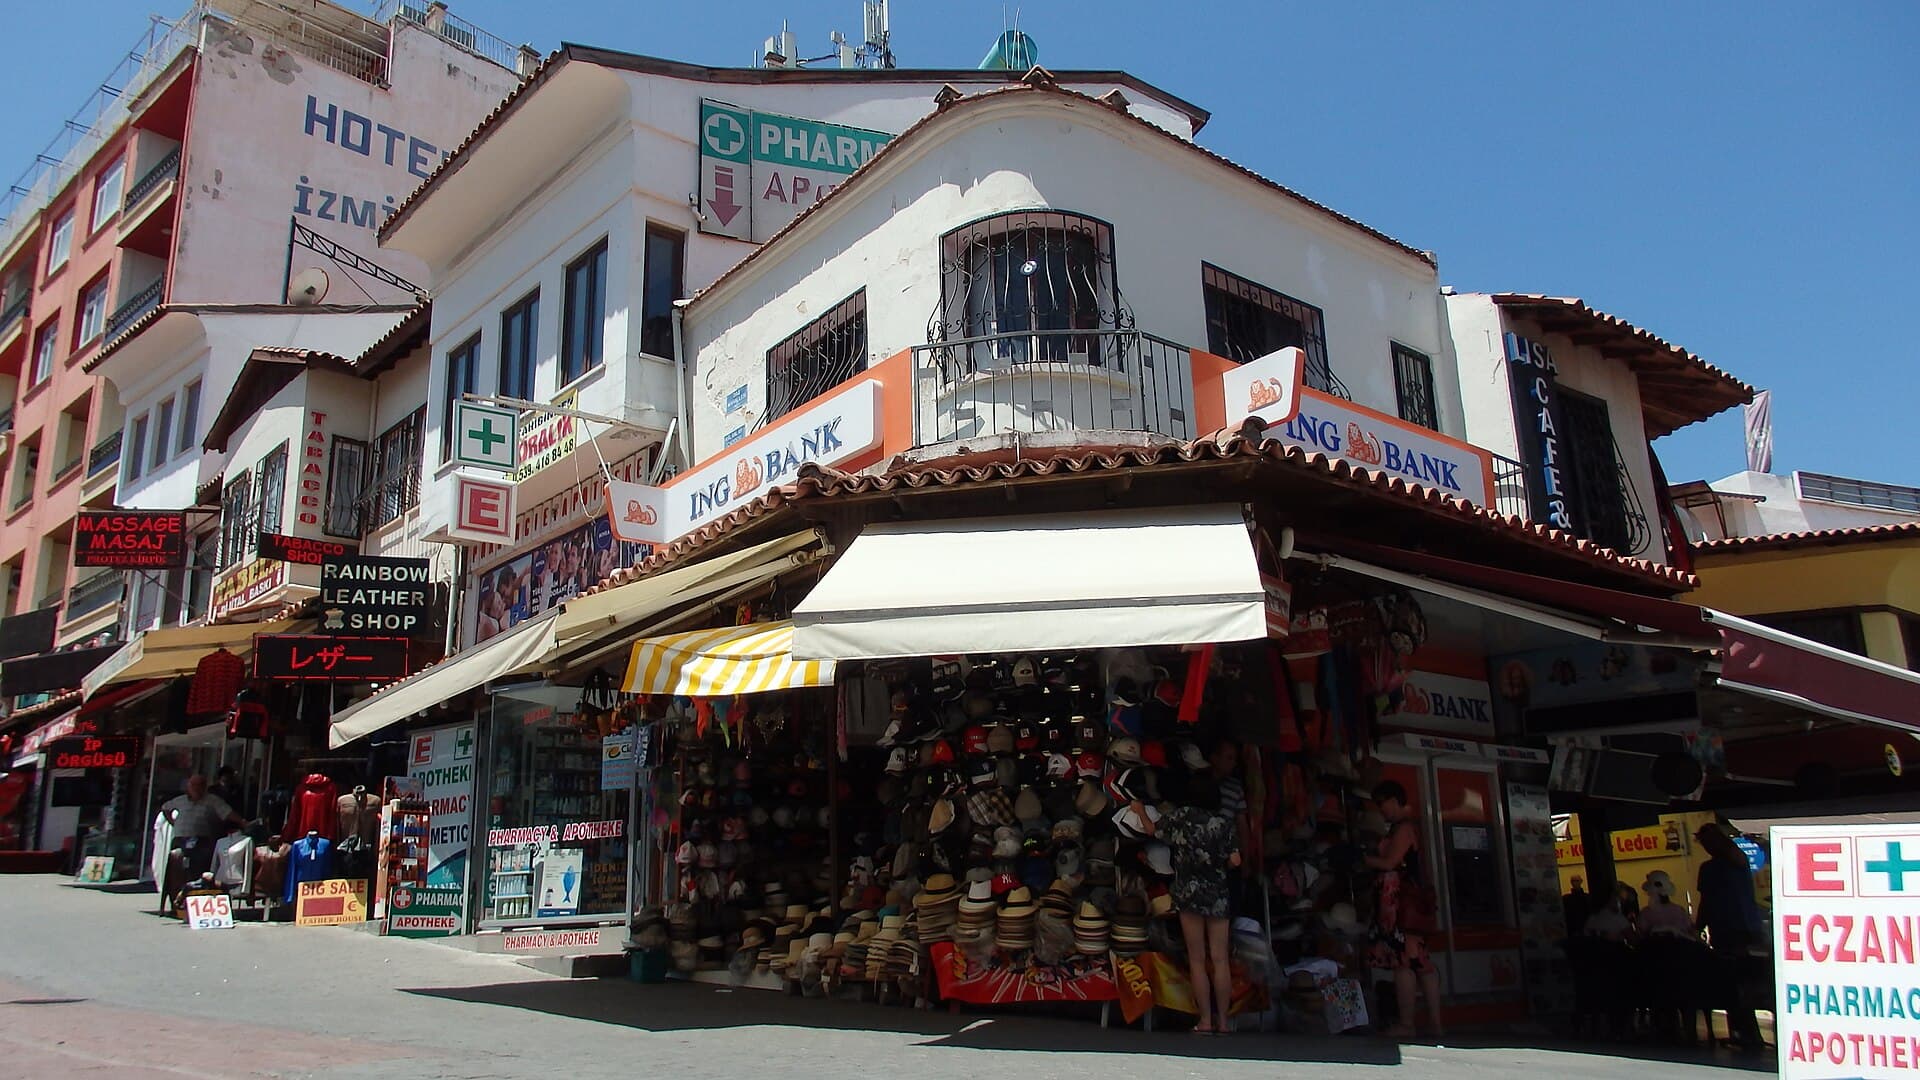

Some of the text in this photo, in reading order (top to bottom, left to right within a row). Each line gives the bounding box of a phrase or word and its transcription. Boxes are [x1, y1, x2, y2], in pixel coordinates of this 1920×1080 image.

[304, 94, 450, 179] HOTE
[1286, 412, 1462, 492] ING BANK
[299, 411, 328, 524] TABACCO
[689, 415, 843, 522] ING BANK
[469, 488, 501, 529] E
[78, 516, 181, 533] MASSAGE
[90, 534, 167, 550] MASAJ
[273, 535, 344, 556] TABACCO
[323, 563, 428, 583] RAINBOW
[323, 588, 425, 606] LEATHER
[350, 613, 417, 630] SHOP
[291, 645, 373, 671] レザー
[1430, 692, 1490, 723] BANK
[56, 751, 126, 768] ÖRGÜSÜ
[413, 737, 432, 764] E
[488, 820, 623, 847] PHARMACY & APOTHEKE
[1616, 834, 1659, 853] Leder
[1796, 843, 1845, 891] E
[301, 880, 365, 897] BIG SALE
[190, 897, 229, 918] 145
[396, 917, 455, 929] APOTHEKE
[505, 930, 599, 950] PHARMACY & APOTHEKE
[1782, 914, 1920, 964] ECZAN
